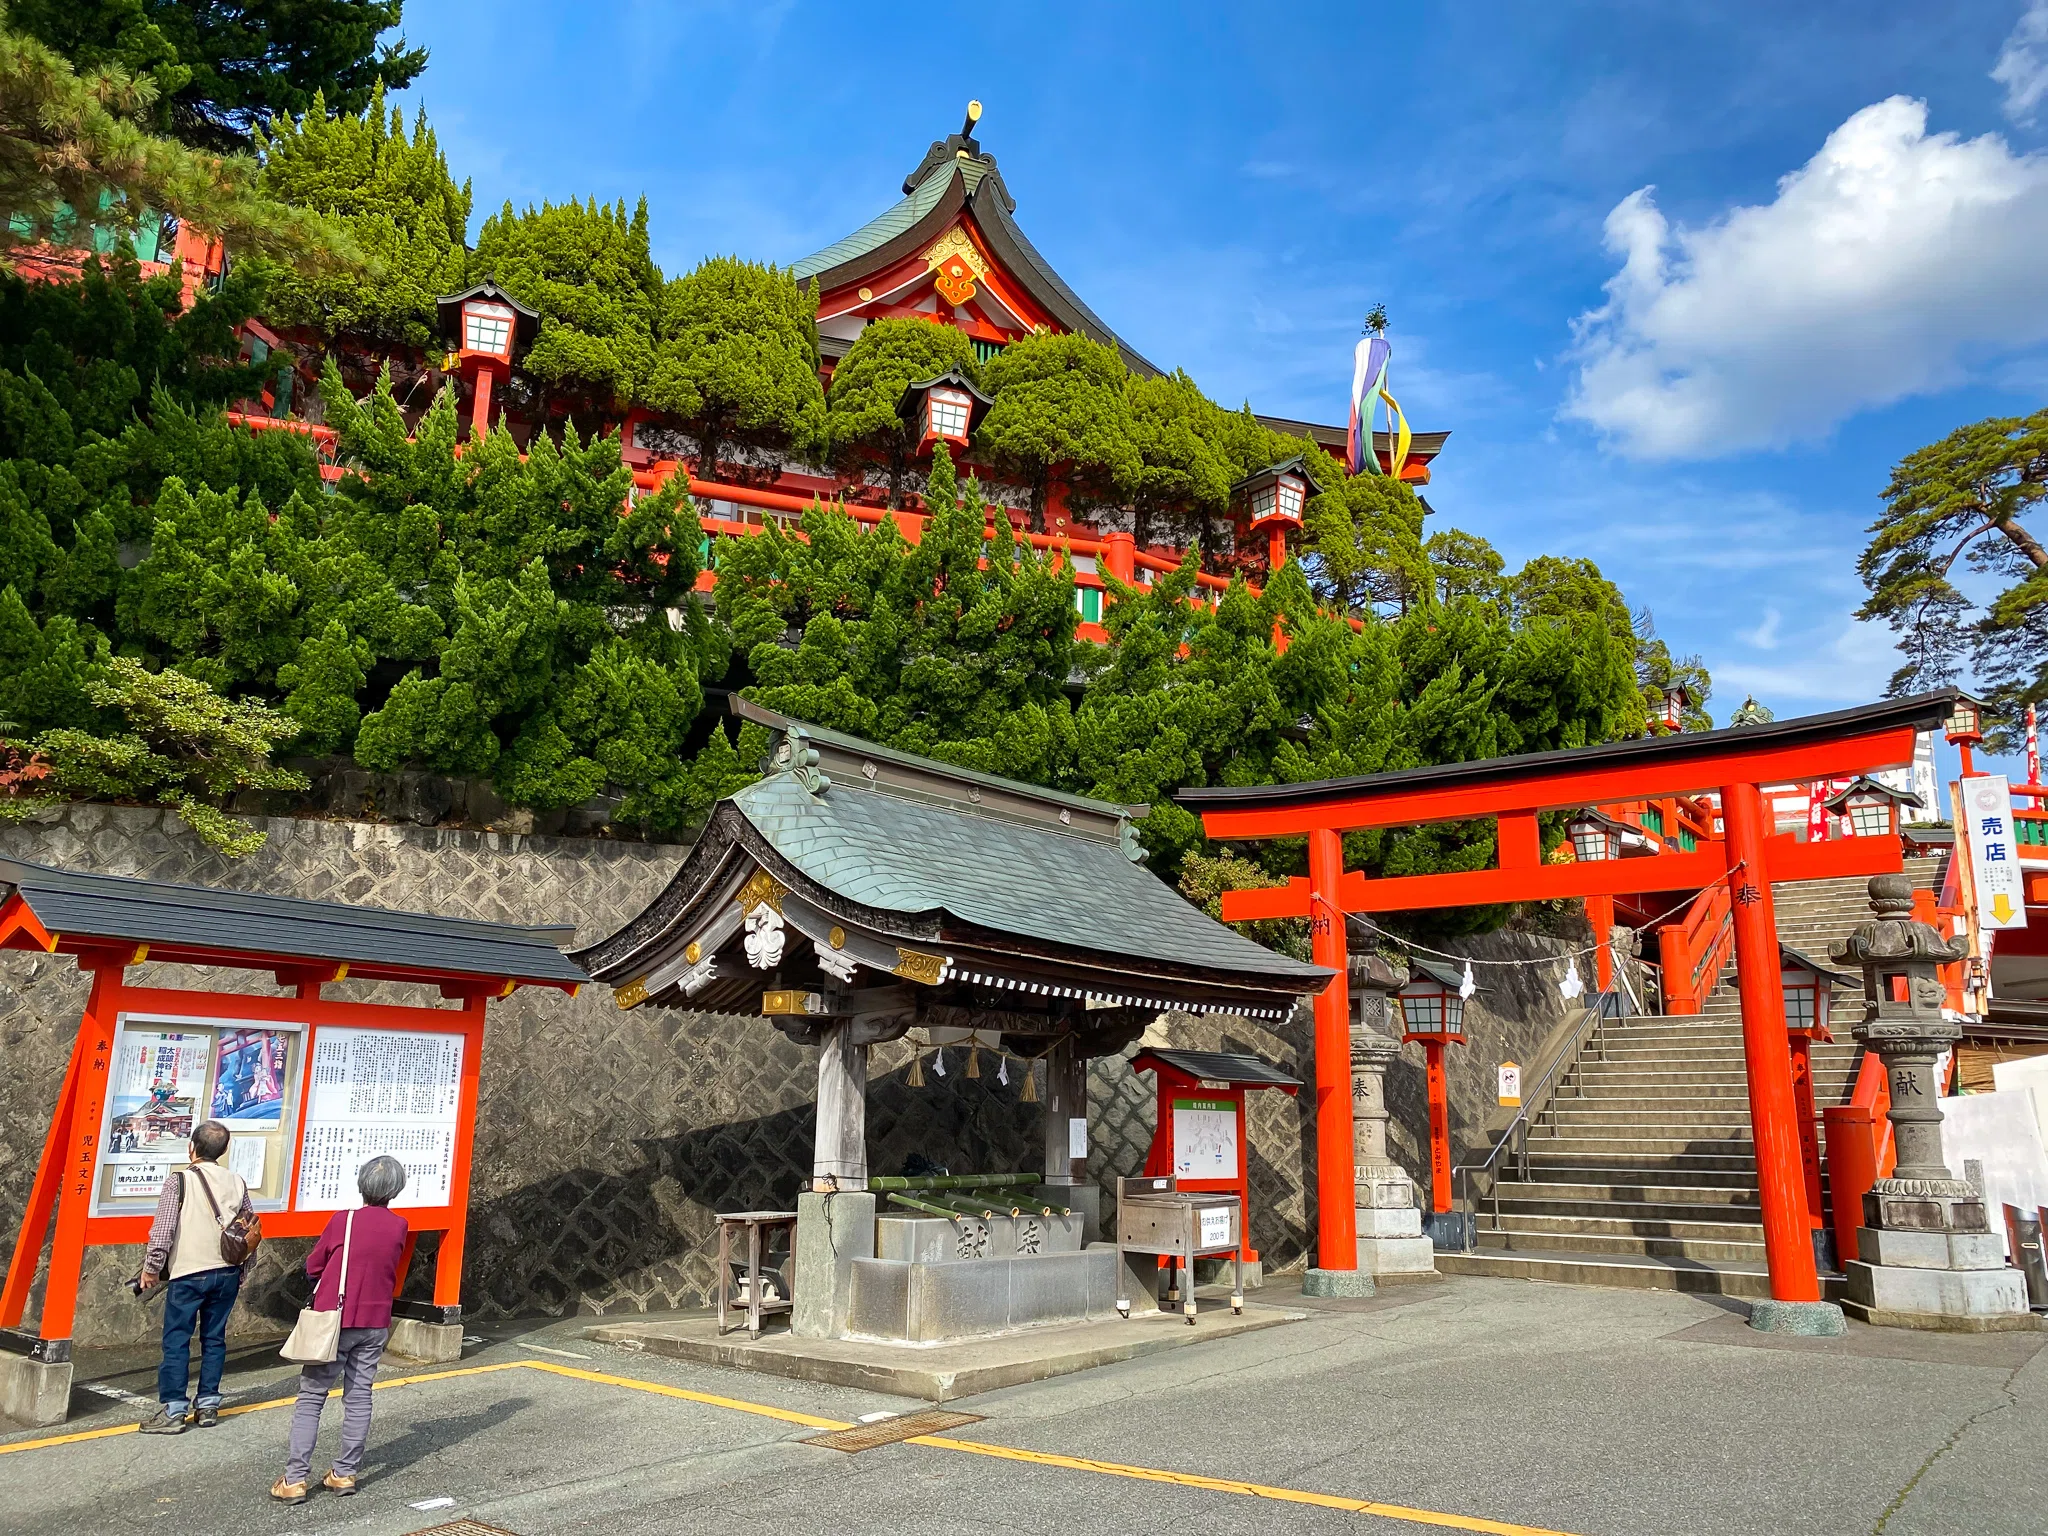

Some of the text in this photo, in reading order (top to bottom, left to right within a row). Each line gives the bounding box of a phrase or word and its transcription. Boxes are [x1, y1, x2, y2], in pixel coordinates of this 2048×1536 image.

[1982, 817, 2006, 861] 売店
[1735, 882, 1762, 908] 奉
[93, 1040, 108, 1071] 奉納
[1352, 1078, 1370, 1102] 奉
[1896, 1071, 1923, 1096] 献
[75, 1135, 94, 1196] 児玉文子
